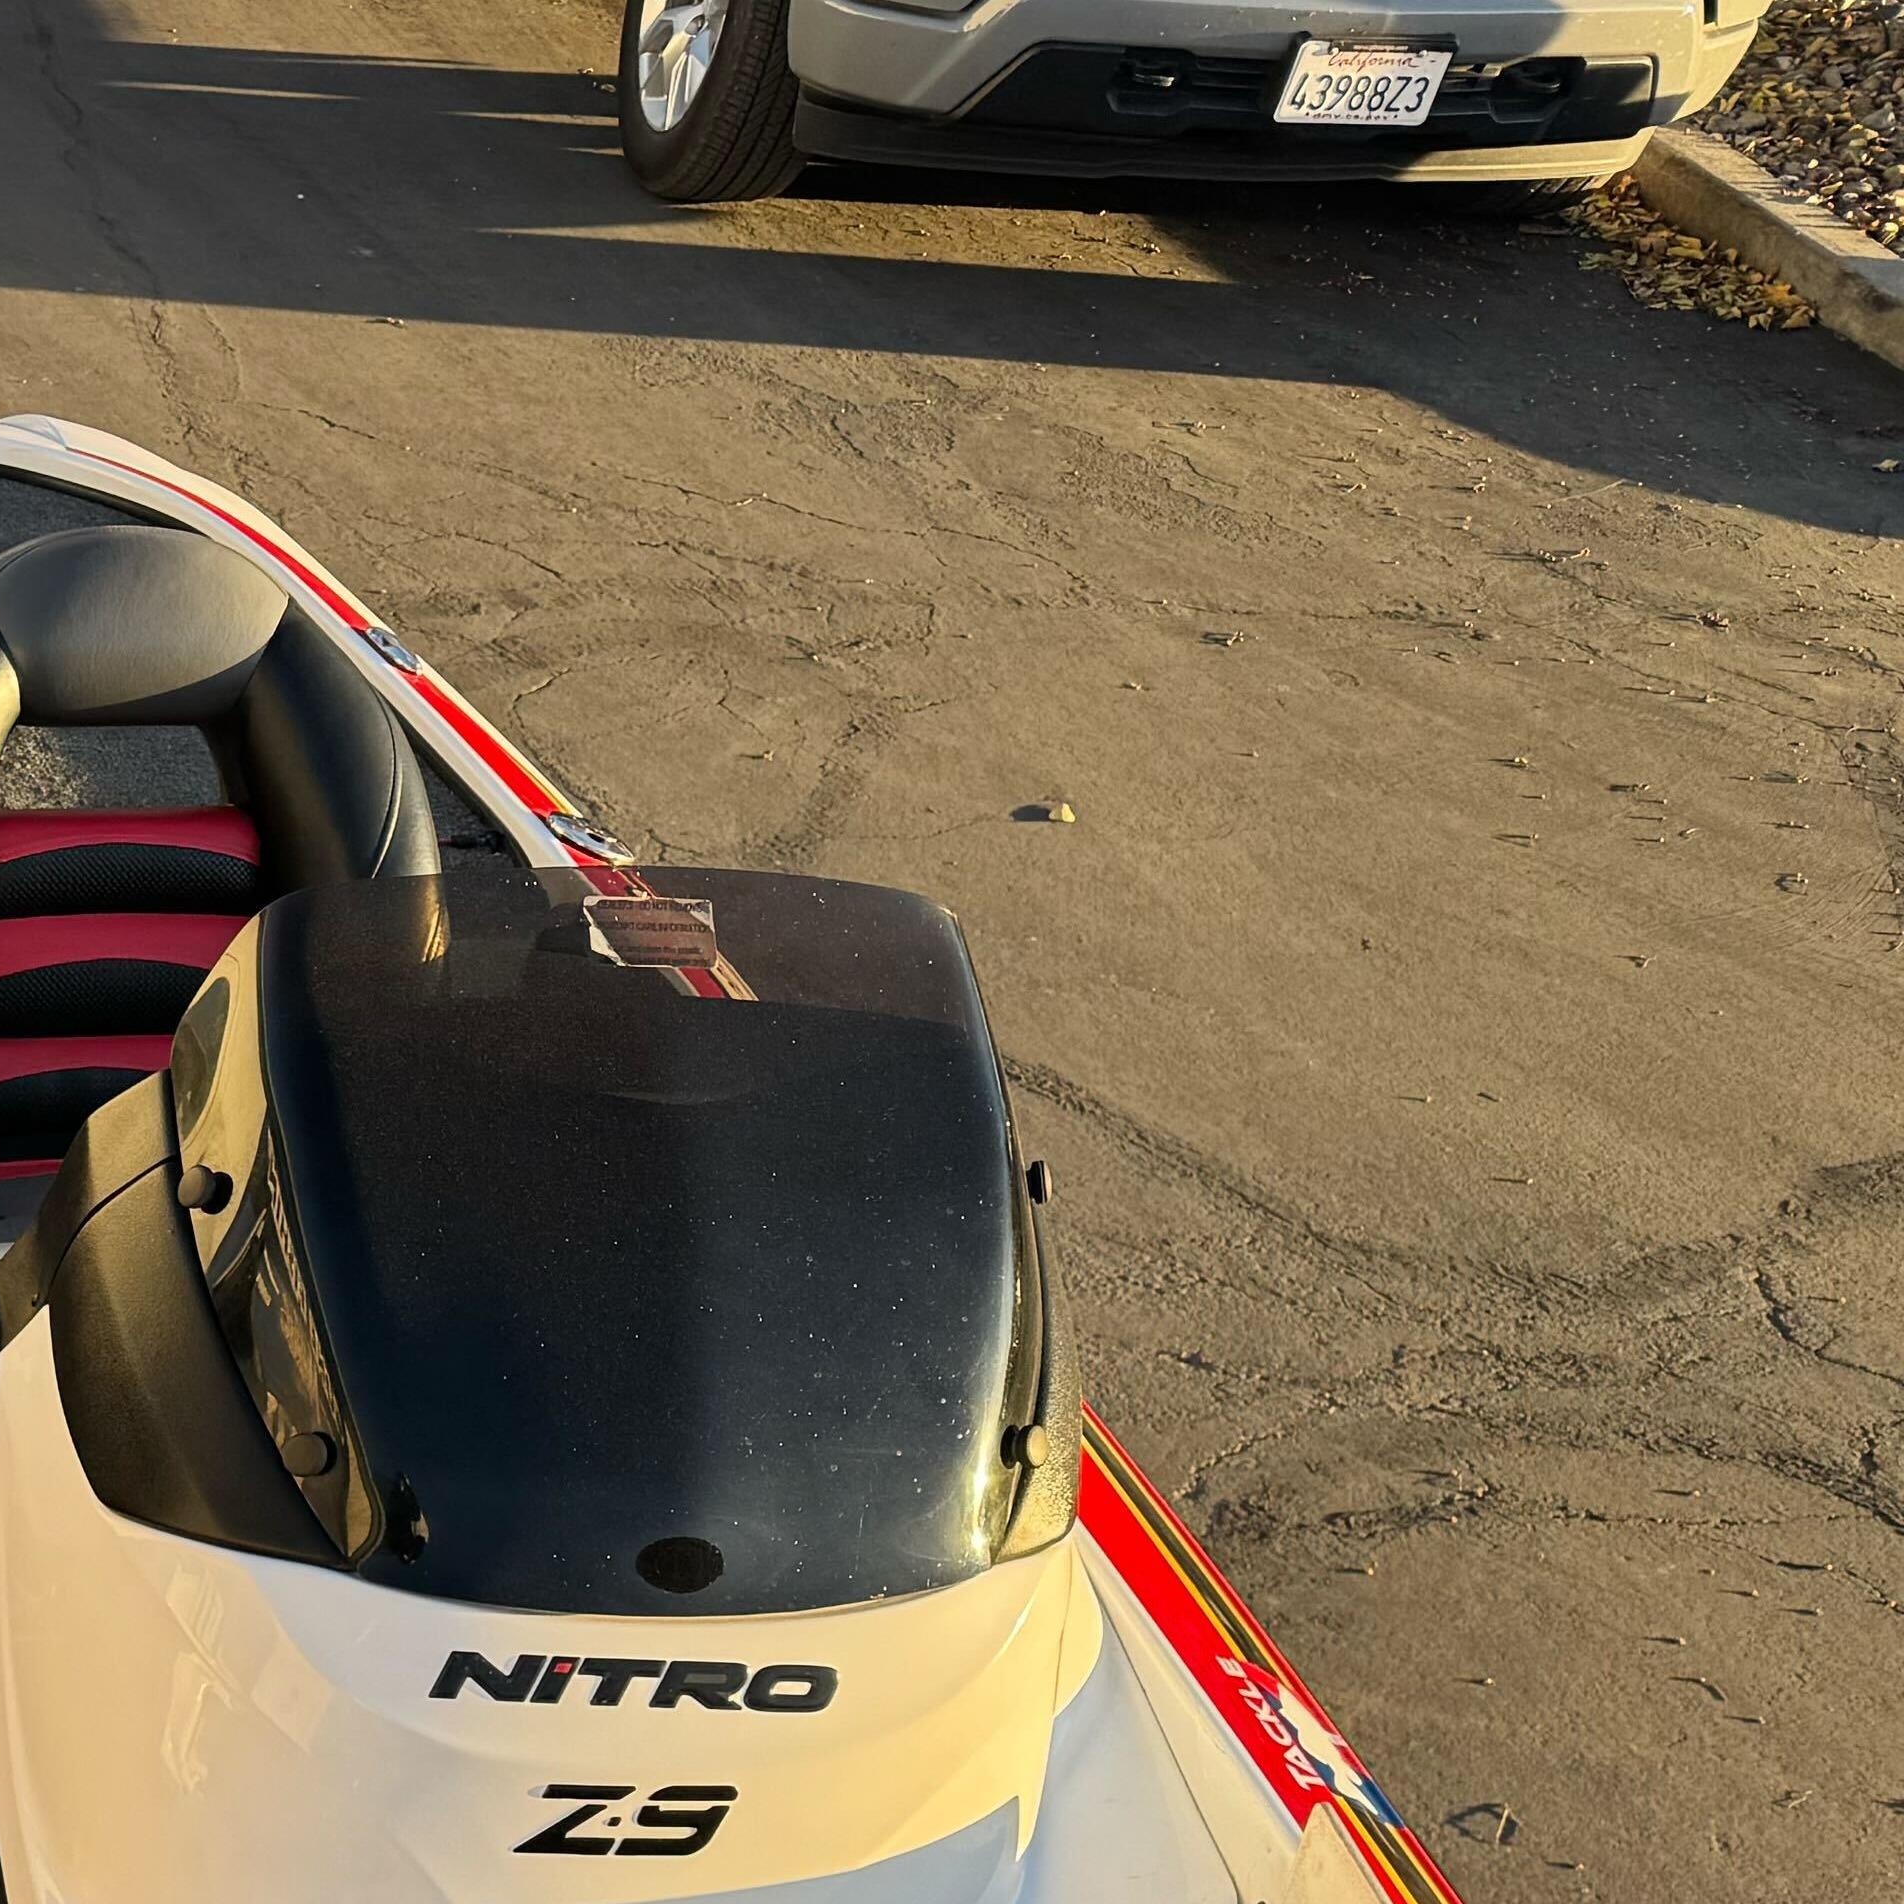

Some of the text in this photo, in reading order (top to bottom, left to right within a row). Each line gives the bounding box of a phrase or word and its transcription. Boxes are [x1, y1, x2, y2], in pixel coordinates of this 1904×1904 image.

[1328, 49, 1420, 72] California
[1289, 72, 1430, 113] 43988Z3
[1215, 1655, 1326, 1792] TACKLE
